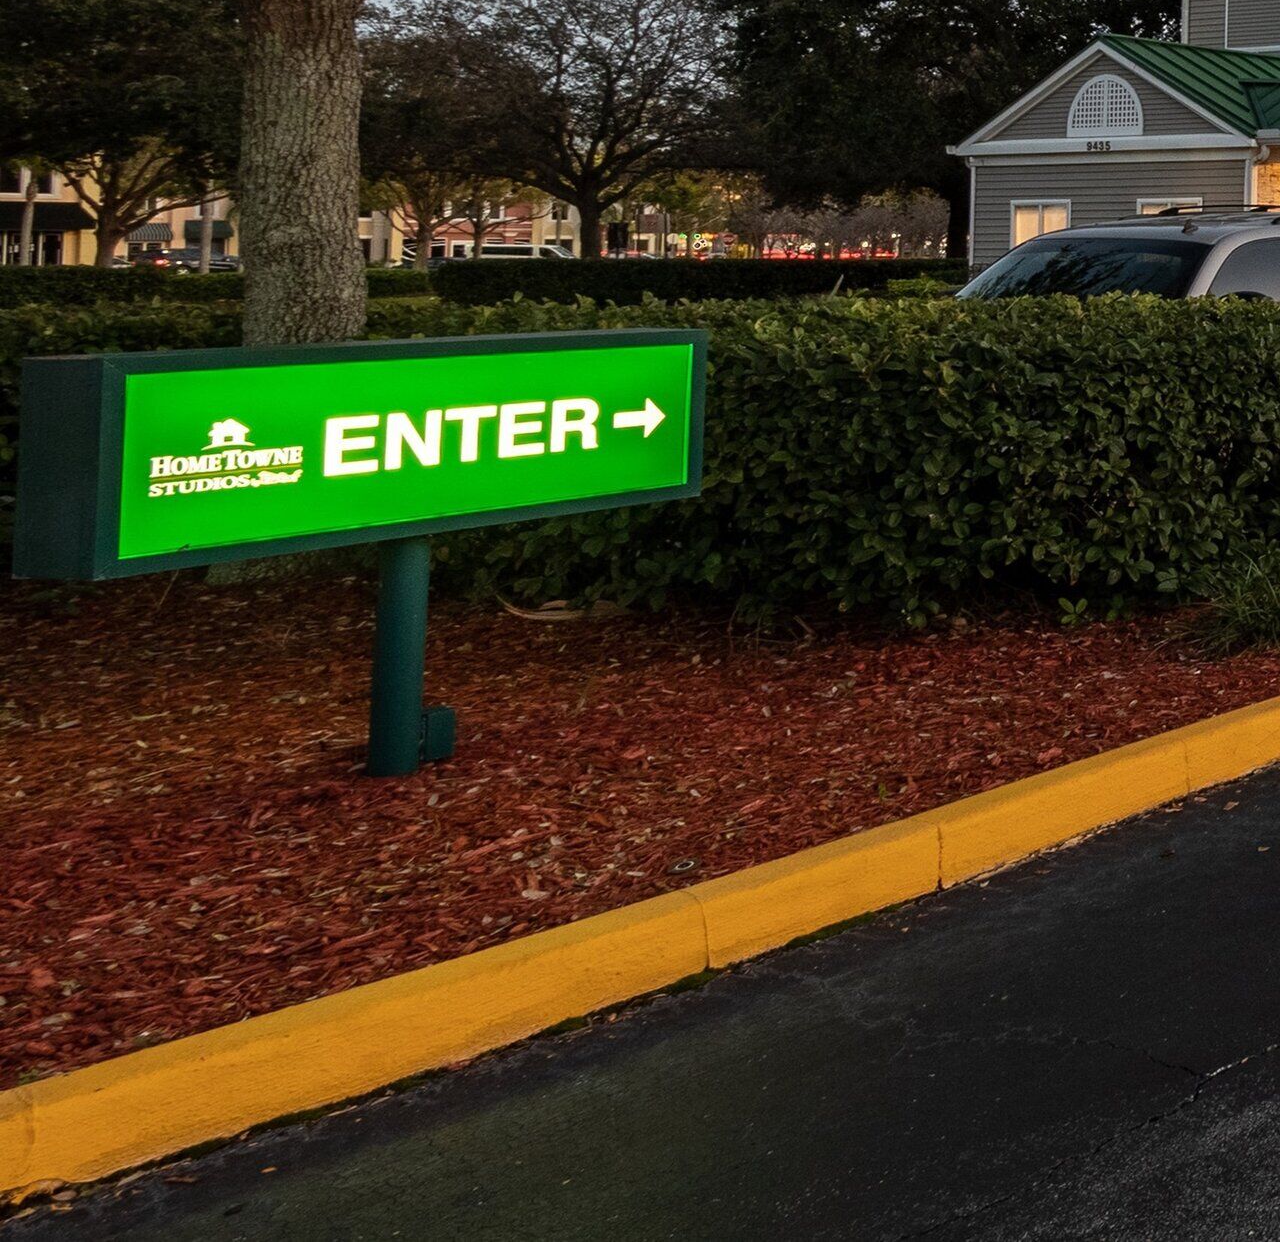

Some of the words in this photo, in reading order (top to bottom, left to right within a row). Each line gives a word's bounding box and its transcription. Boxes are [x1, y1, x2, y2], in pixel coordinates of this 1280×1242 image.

[1086, 140, 1112, 151] 9435
[323, 397, 600, 477] ENTER
[148, 474, 250, 497] STUDIOS
